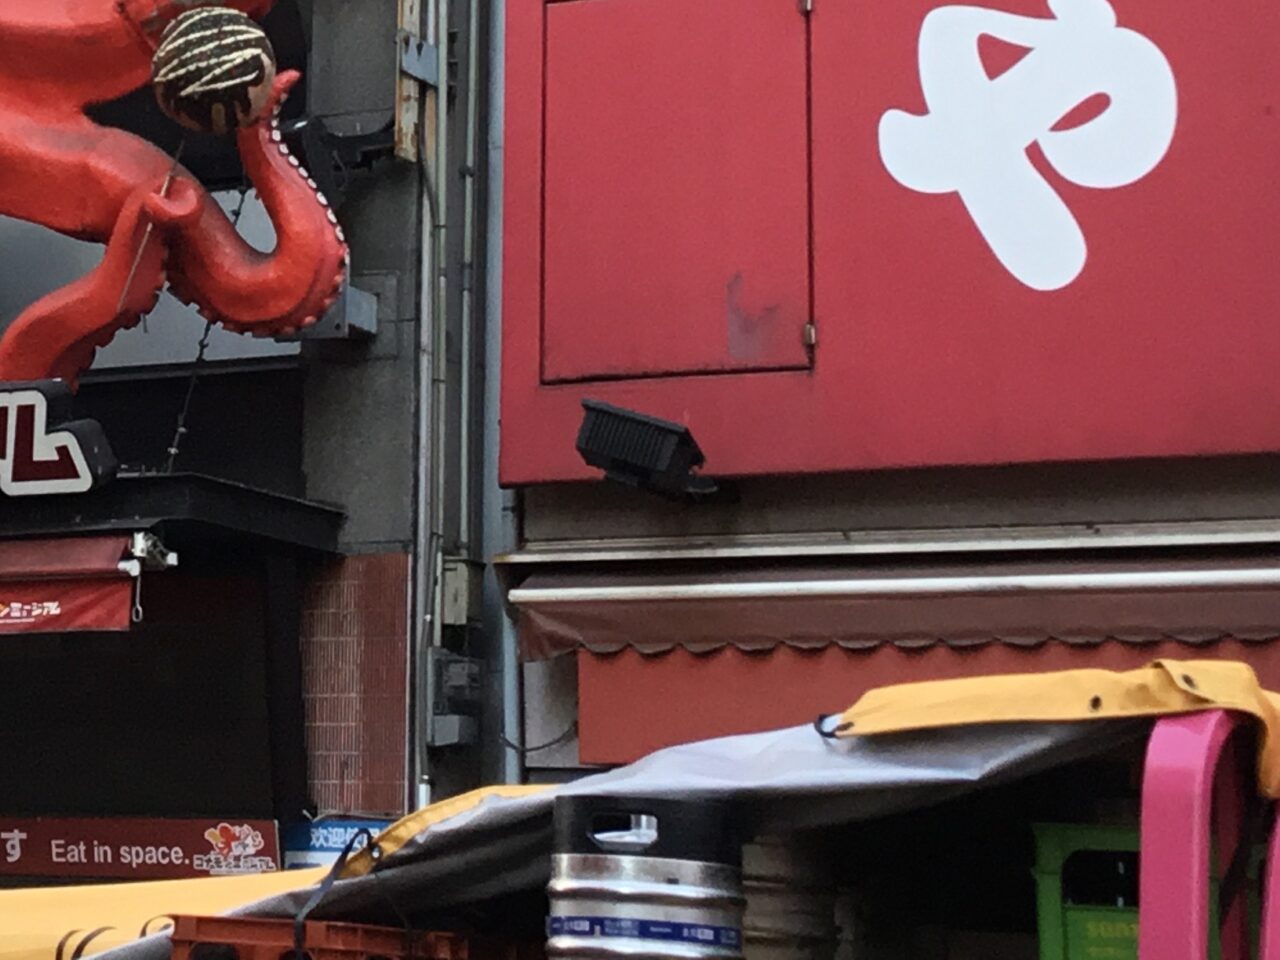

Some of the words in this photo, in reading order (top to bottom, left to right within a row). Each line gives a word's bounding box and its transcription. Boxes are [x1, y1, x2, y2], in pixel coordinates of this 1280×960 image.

[51, 839, 88, 864] Eat
[94, 840, 113, 864] in
[119, 841, 190, 870] space.
